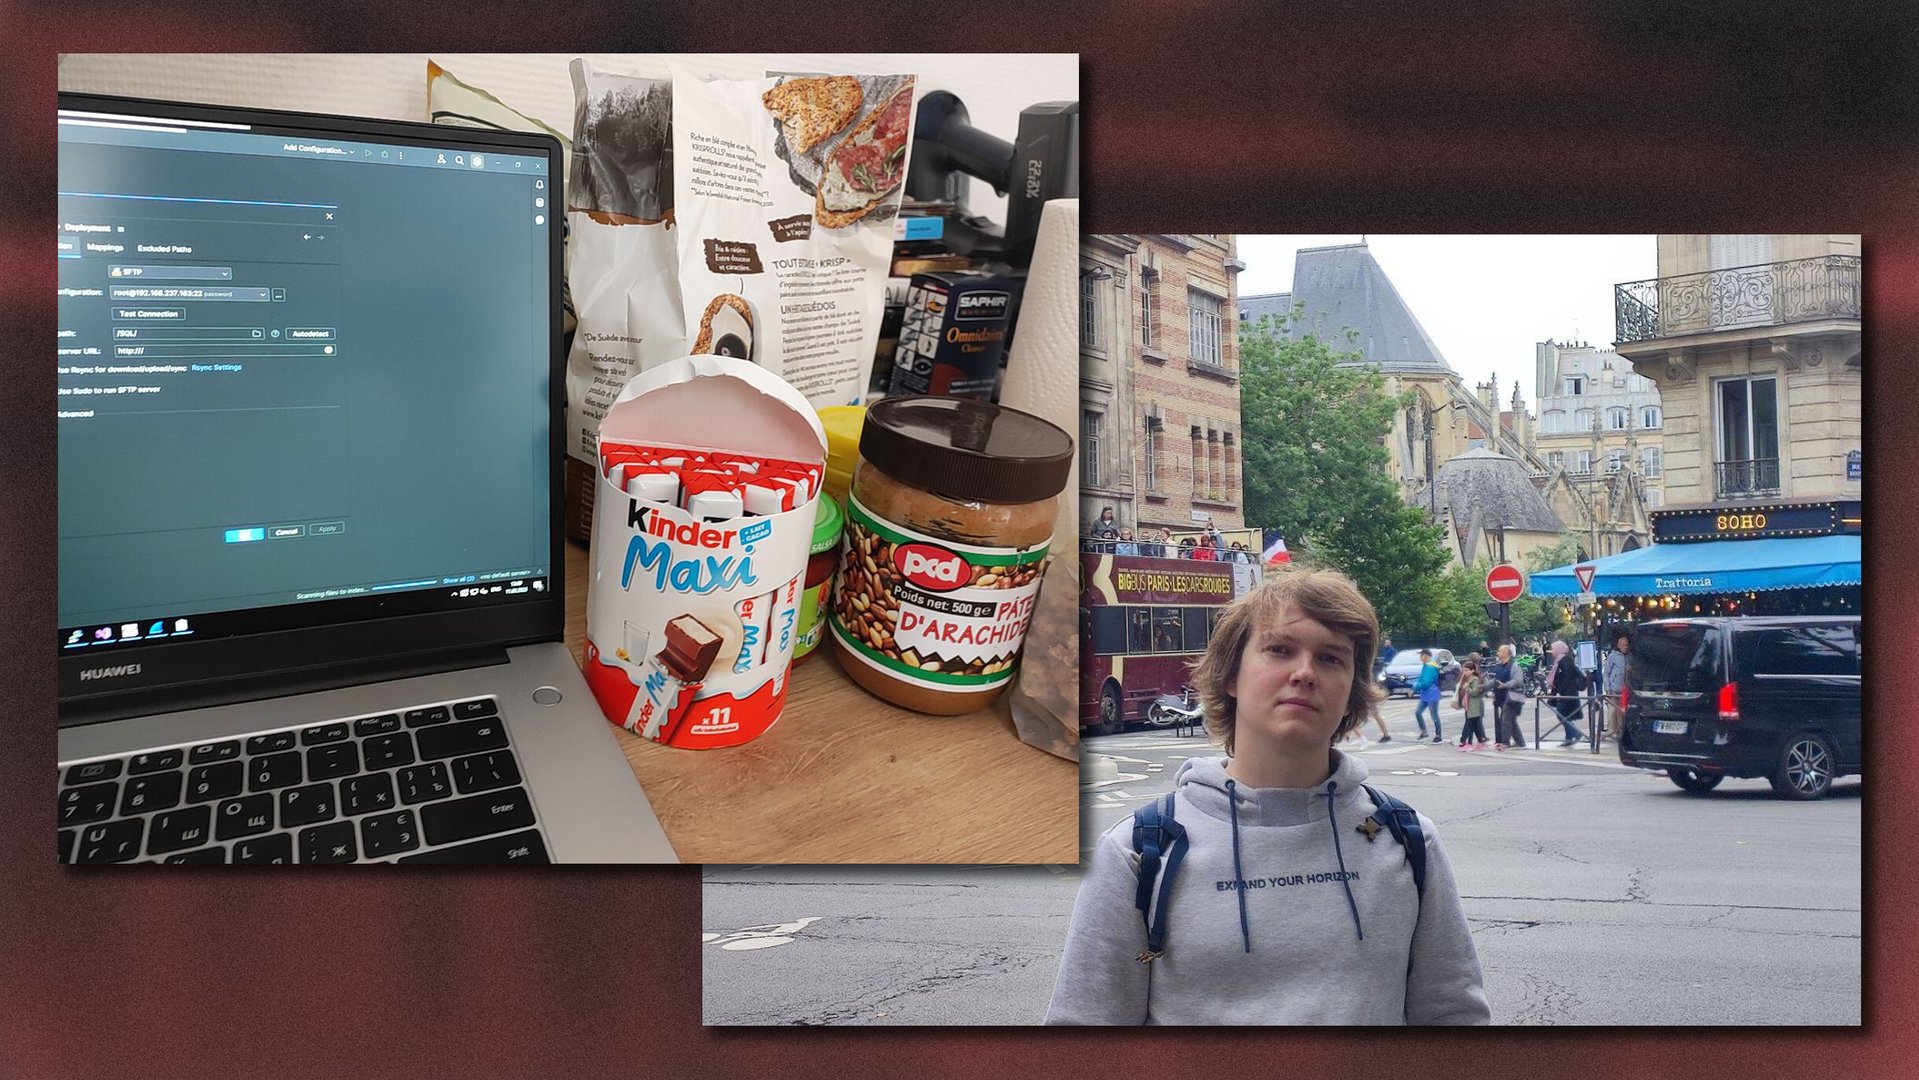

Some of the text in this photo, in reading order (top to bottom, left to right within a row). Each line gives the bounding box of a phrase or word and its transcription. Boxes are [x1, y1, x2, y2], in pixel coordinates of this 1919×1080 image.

[283, 143, 348, 155] Add Configuration...
[65, 223, 111, 232] Deployment
[87, 243, 124, 253] Mappings
[138, 244, 170, 252] Excluded
[715, 254, 730, 262] Entre
[820, 258, 845, 268] KRISP
[960, 296, 1007, 308] SAPHIR
[120, 310, 178, 318] Test Connection
[116, 330, 137, 338] /SQL/
[292, 330, 329, 338] Autodetect
[598, 333, 618, 341] Suède
[83, 347, 101, 355] URL:
[117, 347, 144, 356] http:///
[70, 367, 94, 375] Rsync
[107, 365, 187, 375] download/upload/sync
[191, 364, 213, 373] Rsync
[214, 363, 242, 372] Settings
[73, 387, 93, 395] Sudo
[118, 385, 137, 394] SFTP
[138, 385, 161, 393] server
[1717, 514, 1766, 530] SOHO
[275, 528, 299, 536] Cancel
[318, 526, 337, 534] Apply
[750, 524, 765, 533] LAIT
[746, 529, 769, 542] CACAO
[621, 535, 757, 594] Maxi
[903, 550, 961, 583] pcd
[1655, 577, 1712, 588] Trattoria
[296, 592, 325, 600] Scanning
[326, 589, 339, 597] files
[894, 584, 925, 606] Poids
[926, 599, 949, 612] net:
[951, 603, 972, 615] 500
[80, 663, 141, 681] HUAWEI
[198, 782, 210, 794] 9
[131, 794, 144, 807] 8
[288, 792, 299, 804] P
[65, 805, 78, 818] 7
[491, 803, 514, 814] Enter
[90, 828, 106, 842] U
[241, 846, 253, 859] L
[507, 846, 530, 859] Shift
[1268, 875, 1305, 887] YOUR
[1307, 871, 1360, 884] HORIZON
